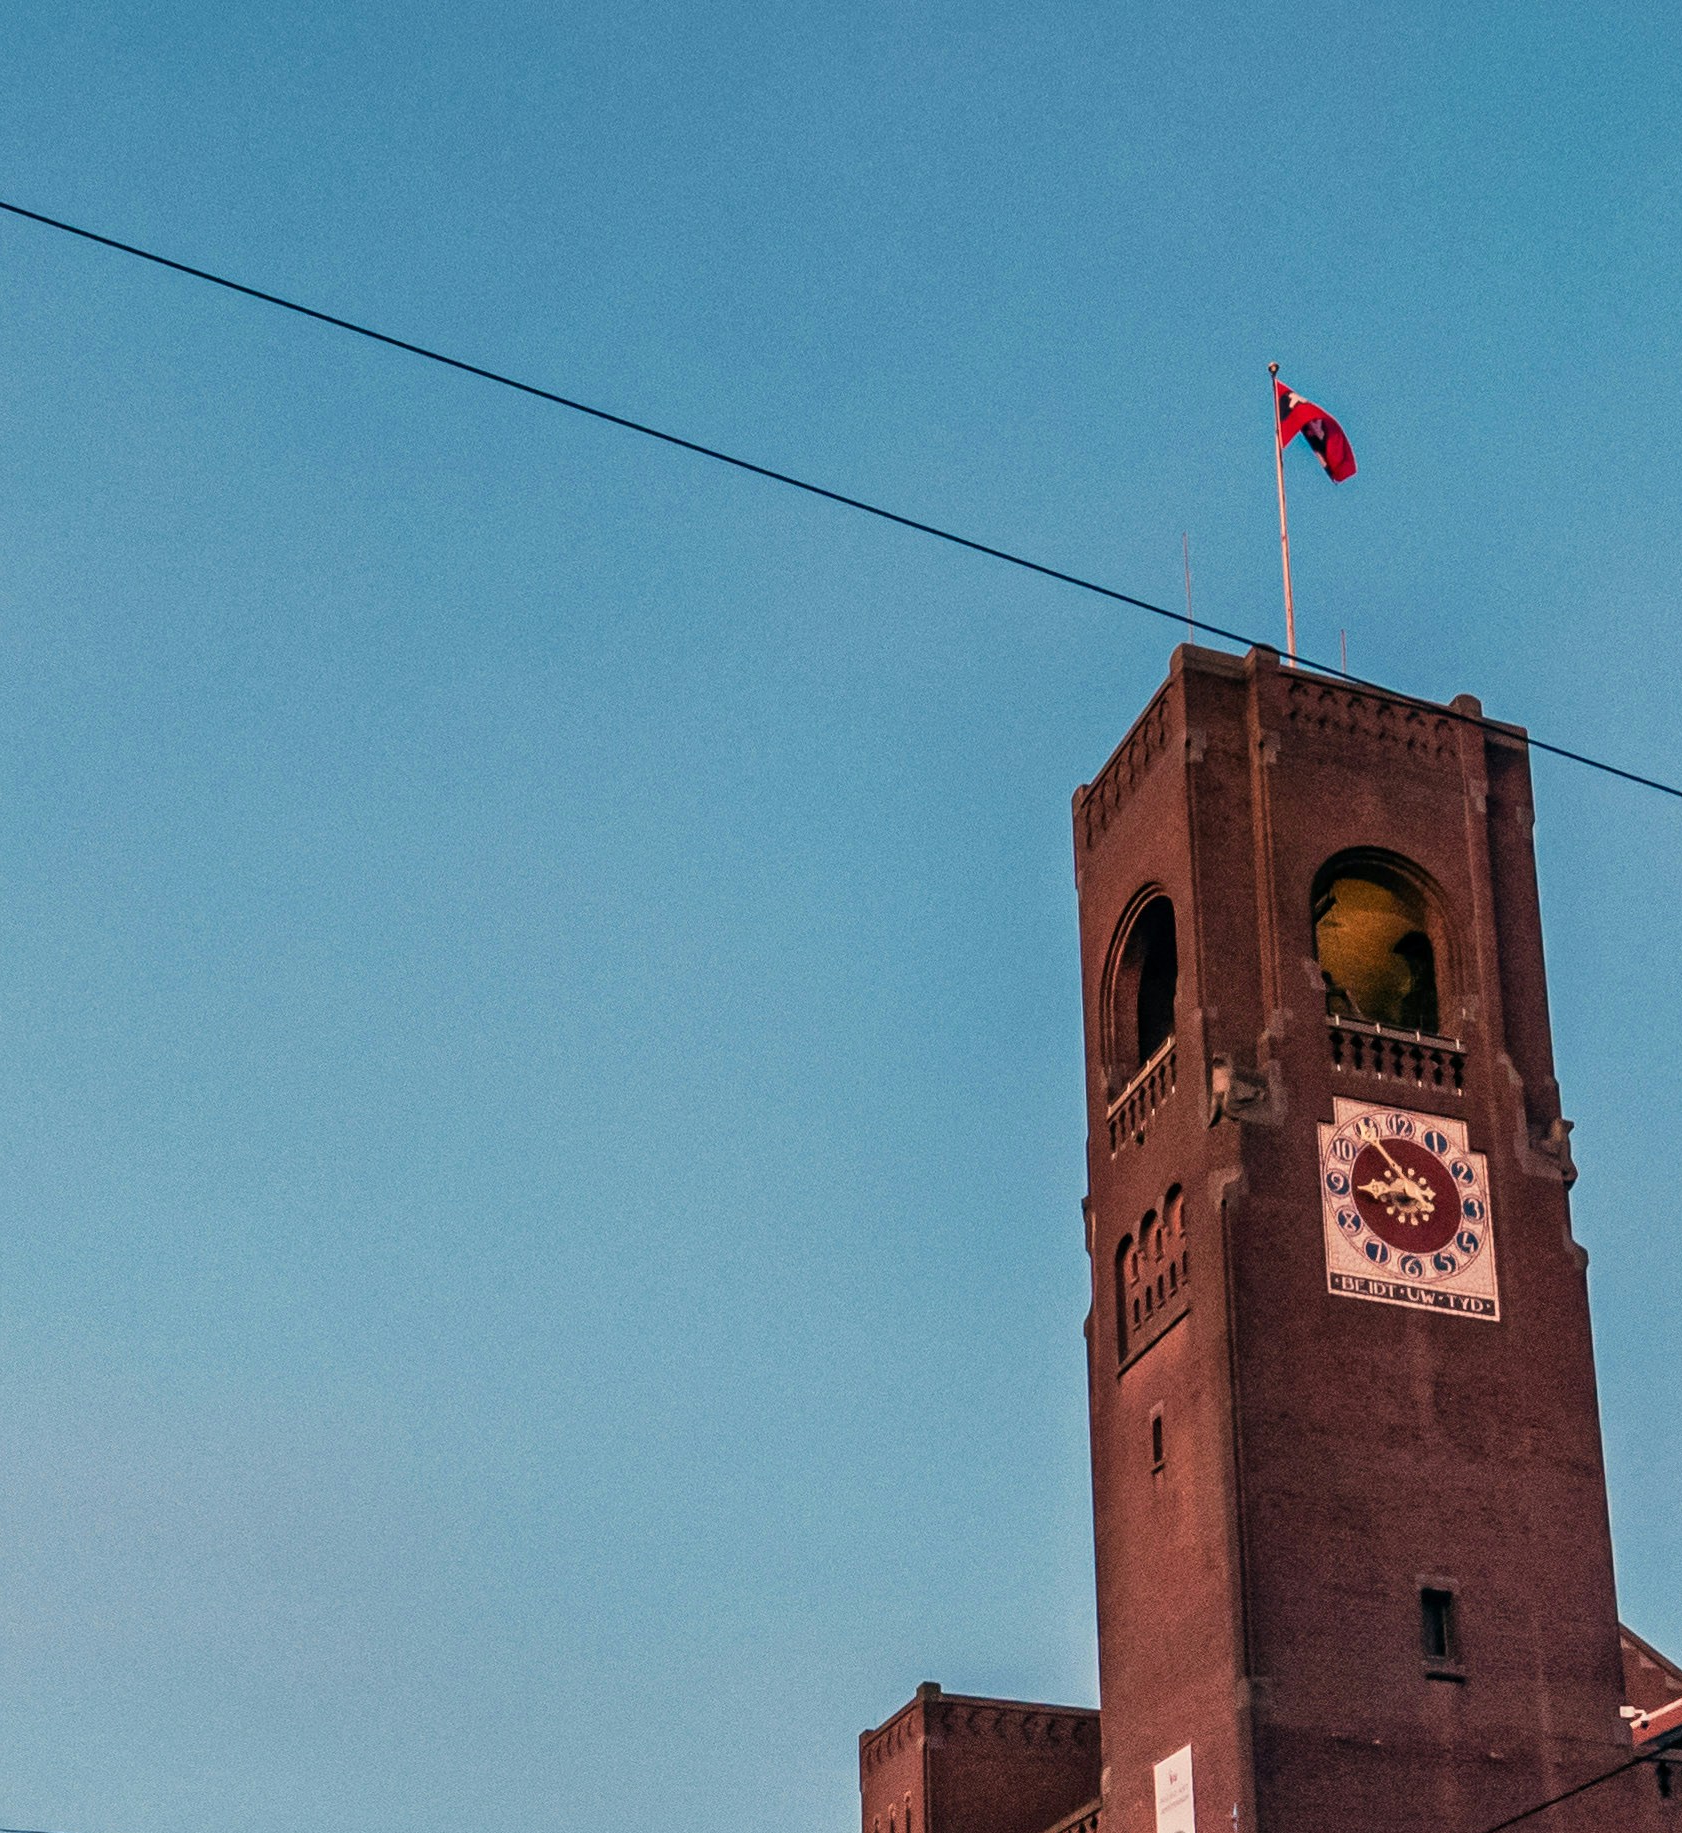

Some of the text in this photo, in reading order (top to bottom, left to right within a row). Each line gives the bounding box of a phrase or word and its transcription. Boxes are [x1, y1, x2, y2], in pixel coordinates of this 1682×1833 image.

[1342, 1276, 1485, 1313] BEIDT UW TYD
